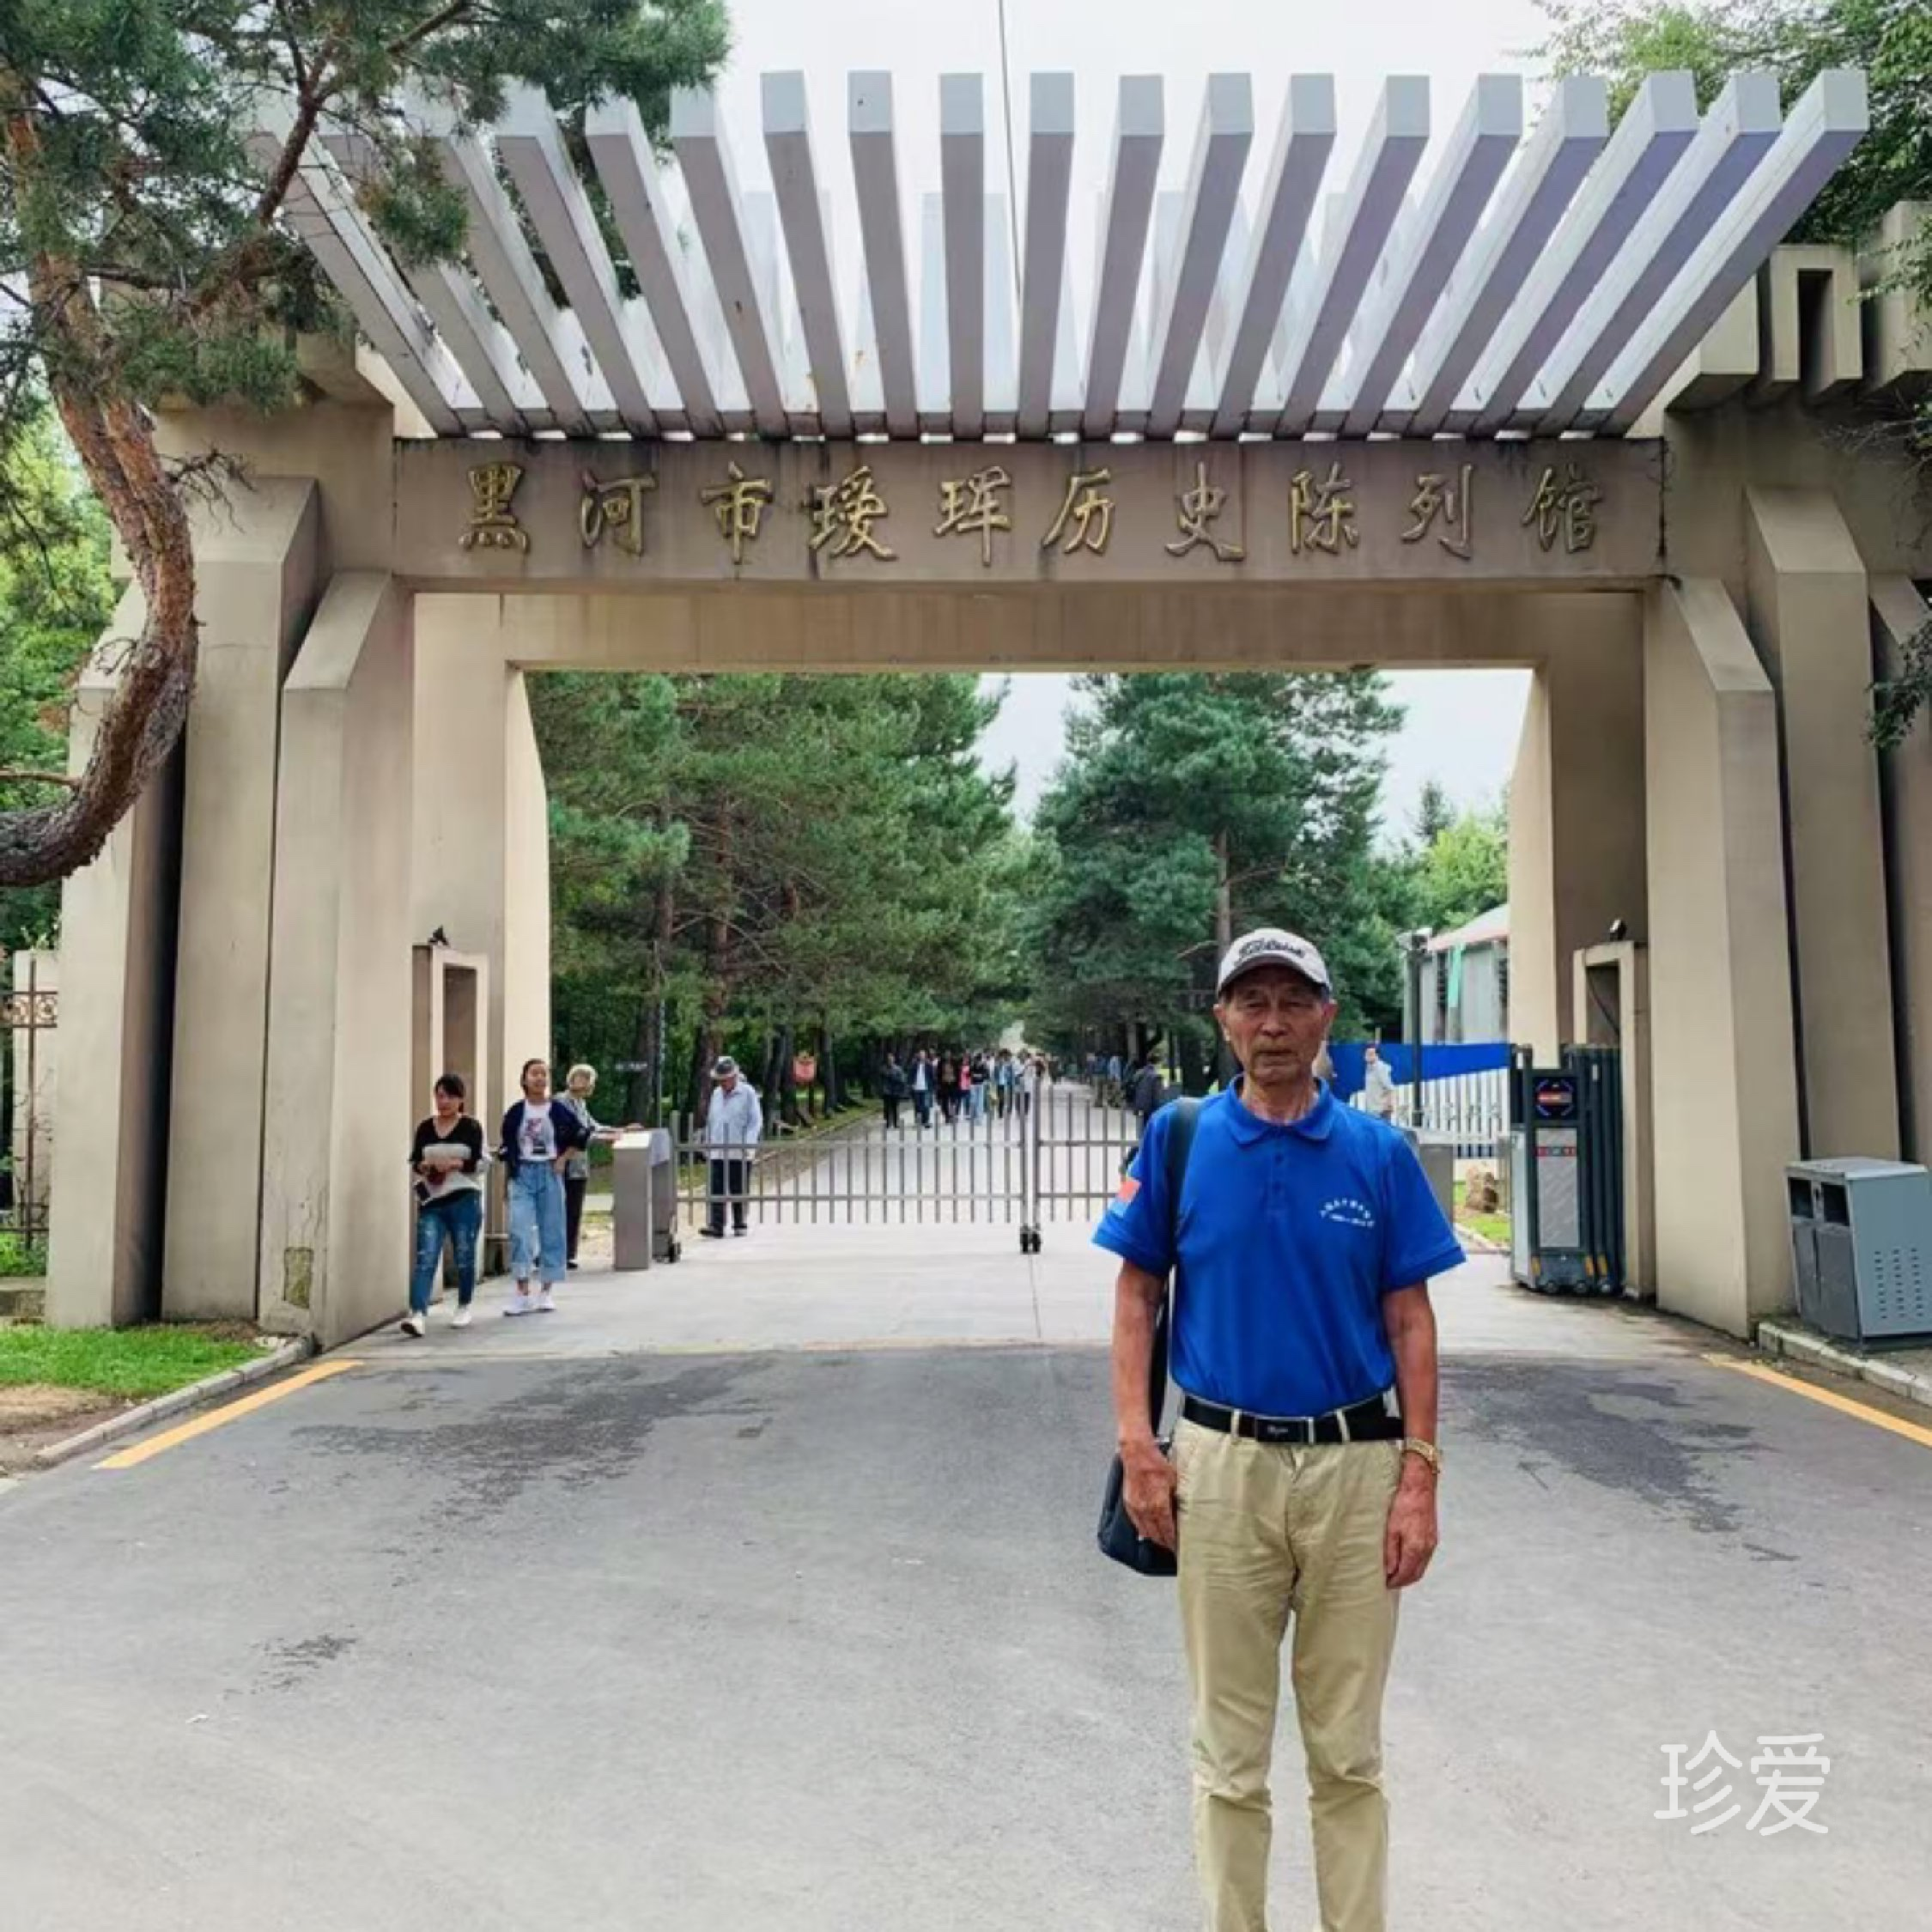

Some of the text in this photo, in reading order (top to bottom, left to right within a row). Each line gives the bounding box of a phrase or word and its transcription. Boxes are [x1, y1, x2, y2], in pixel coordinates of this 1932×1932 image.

[458, 461, 1602, 566] 黑河市瑷珲历史陈列馆
